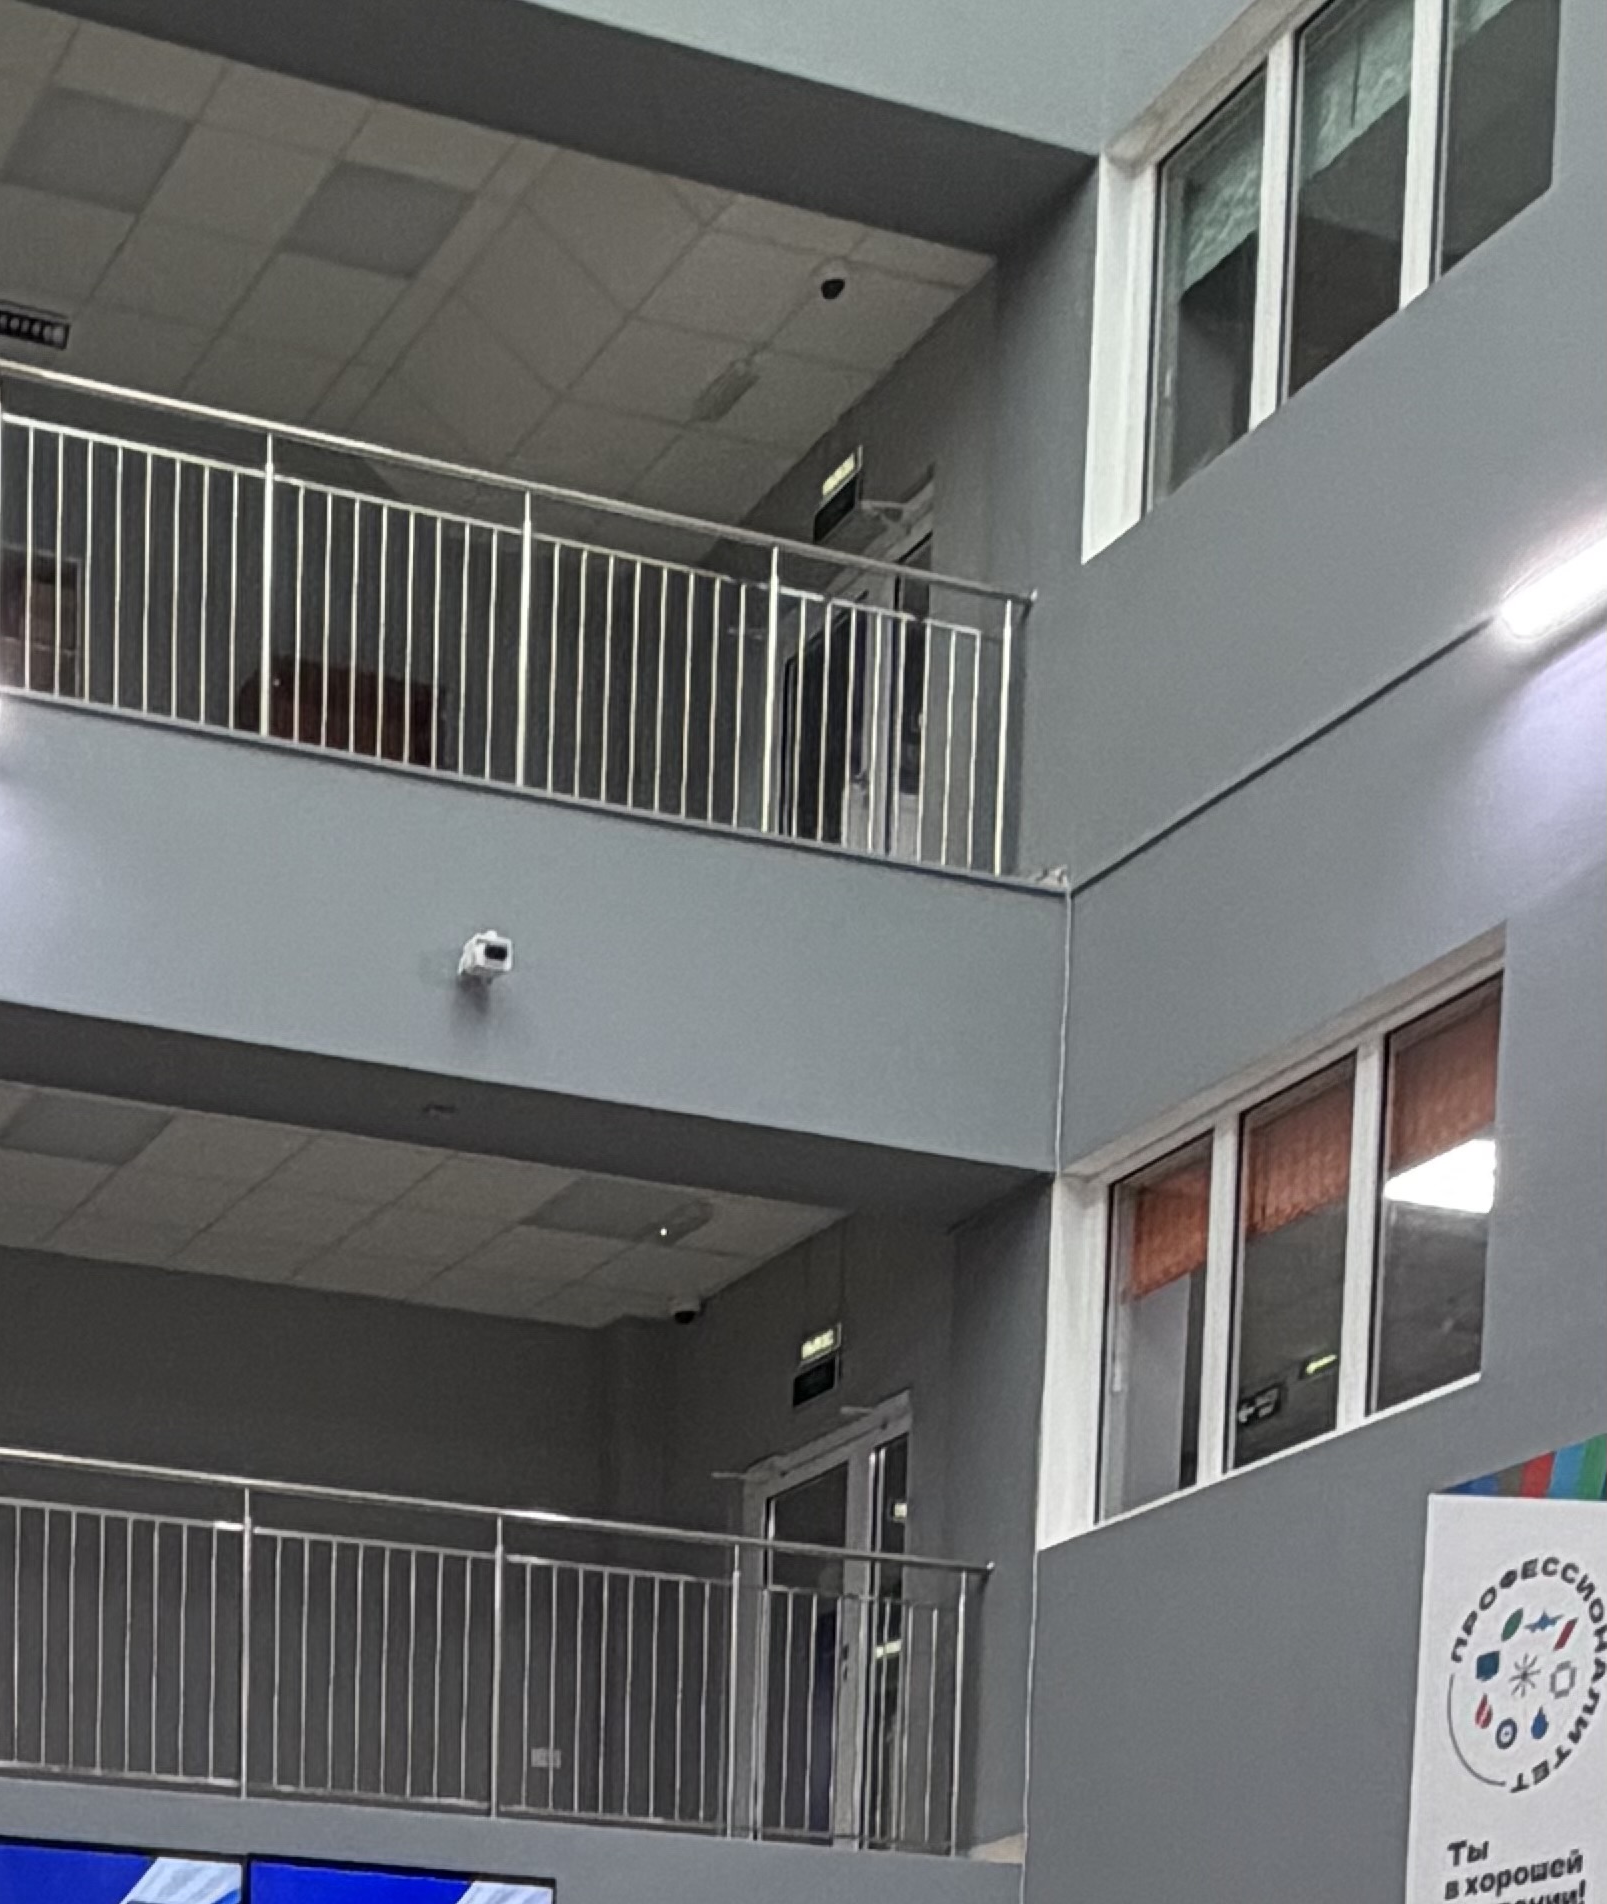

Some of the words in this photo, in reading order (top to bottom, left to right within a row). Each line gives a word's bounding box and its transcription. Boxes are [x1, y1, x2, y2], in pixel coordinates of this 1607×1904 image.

[1451, 1556, 1607, 1794] ПРОФЕССИОНАЛИТЕТ
[1444, 1880, 1459, 1901] в
[1465, 1848, 1584, 1898] хорошей
[1447, 1839, 1489, 1867] Ты
